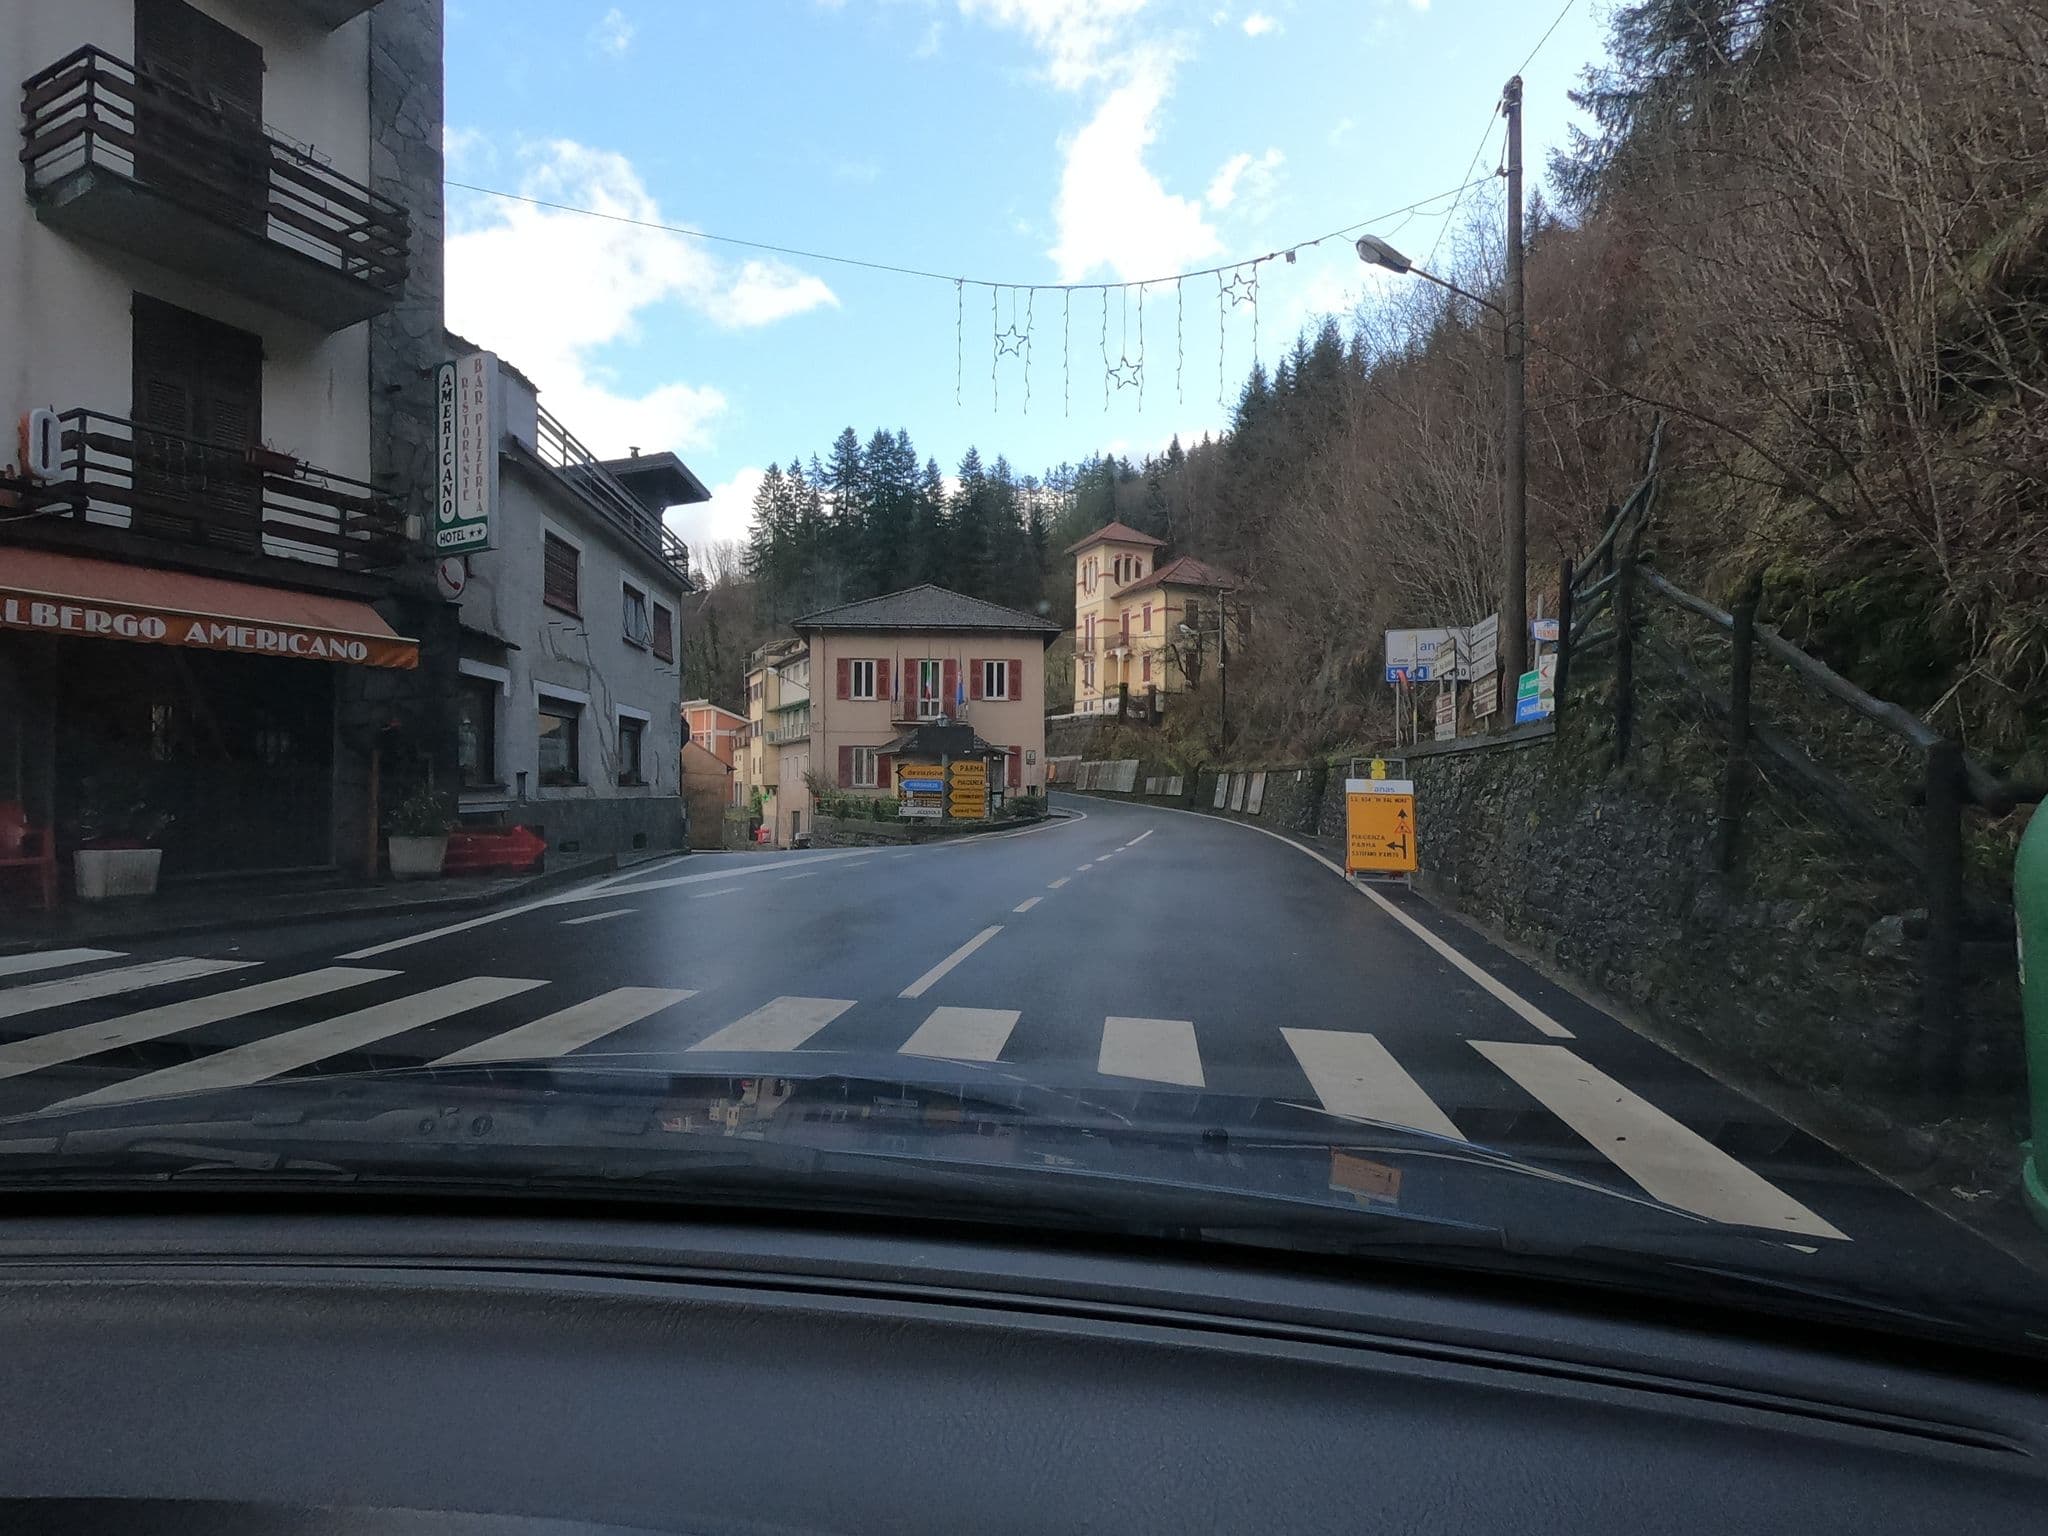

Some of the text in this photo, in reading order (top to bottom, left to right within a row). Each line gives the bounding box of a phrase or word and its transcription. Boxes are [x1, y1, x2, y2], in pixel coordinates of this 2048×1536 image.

[441, 373, 453, 515] AMERICANO
[461, 377, 470, 501] RISTORANTE
[474, 358, 484, 513] BAR PIZZERIA
[439, 529, 466, 546] HOTEL
[0, 598, 369, 662] LBERGO AMERICANO
[960, 764, 984, 772] PARMA
